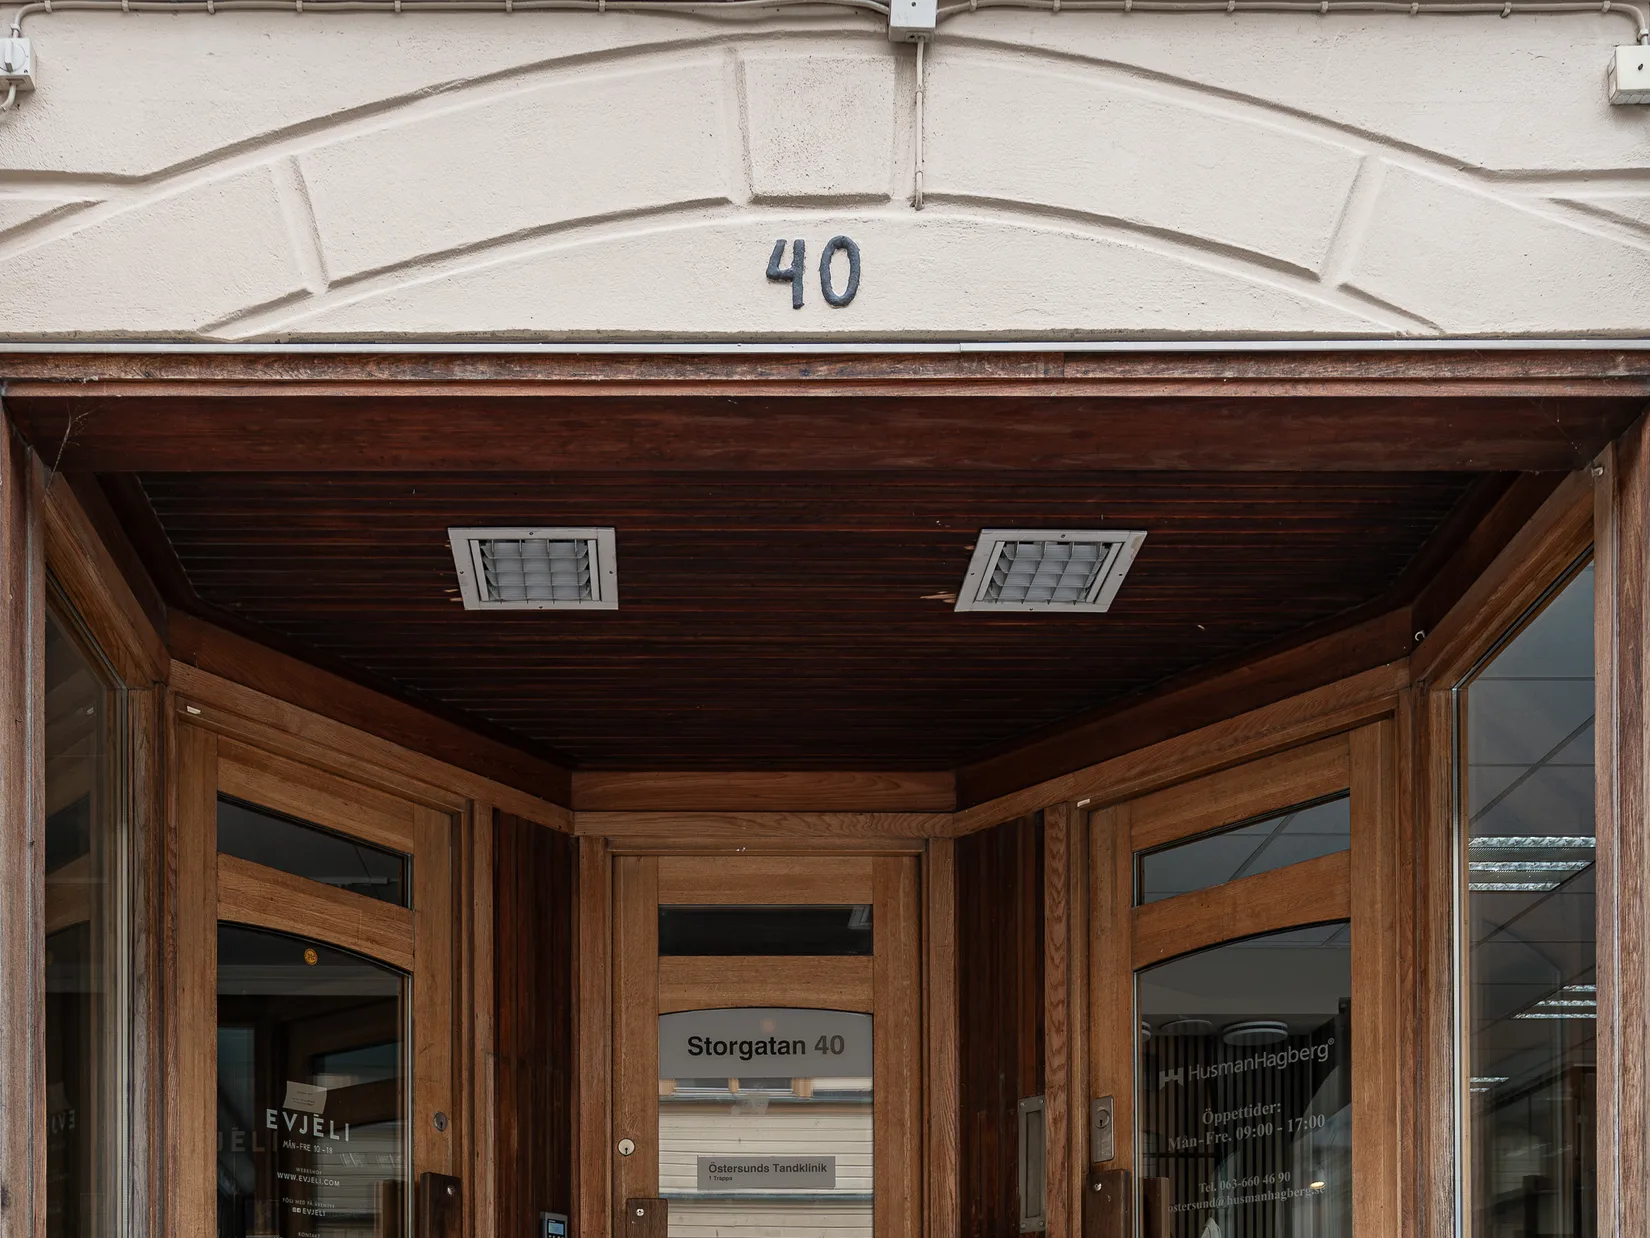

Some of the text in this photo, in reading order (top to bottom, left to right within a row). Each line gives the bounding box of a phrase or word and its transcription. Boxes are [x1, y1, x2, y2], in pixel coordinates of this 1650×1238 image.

[765, 235, 861, 310] 40
[687, 1035, 845, 1061] Storgatan 40
[1202, 1102, 1282, 1127] Öppettider:
[1235, 1122, 1273, 1141] 09:00
[1288, 1114, 1326, 1133] 17:00
[708, 1162, 828, 1174] Östersunds Tandklinik
[1199, 1171, 1291, 1194] Tel. 063-660 46 90
